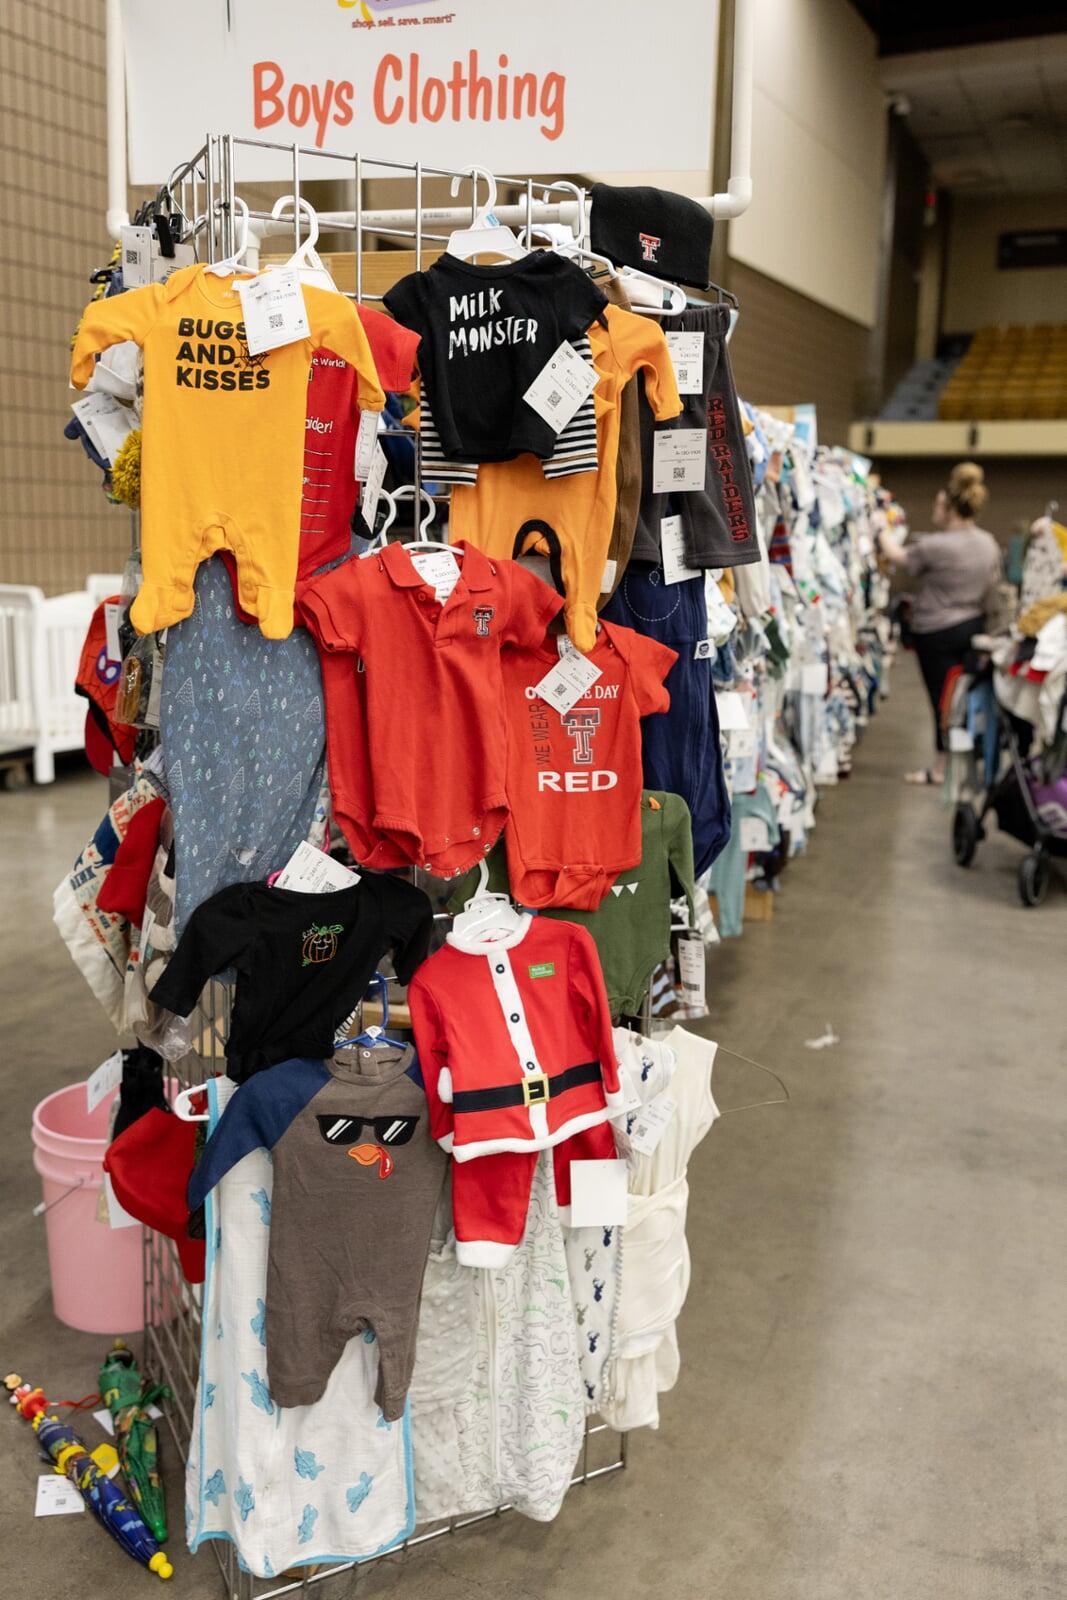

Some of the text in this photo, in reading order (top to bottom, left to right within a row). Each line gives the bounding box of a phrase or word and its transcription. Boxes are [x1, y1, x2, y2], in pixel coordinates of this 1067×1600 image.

[253, 49, 566, 148] Boys Clothing
[178, 317, 248, 340] BUGS
[448, 315, 539, 360] MONSTER
[176, 341, 236, 365] AND
[176, 365, 270, 391] KISSES
[305, 416, 334, 434] aider!
[707, 397, 750, 542] RED RAIDERS
[595, 685, 620, 699] DAY
[529, 702, 550, 766] WE WEAR
[538, 770, 618, 793] RED
